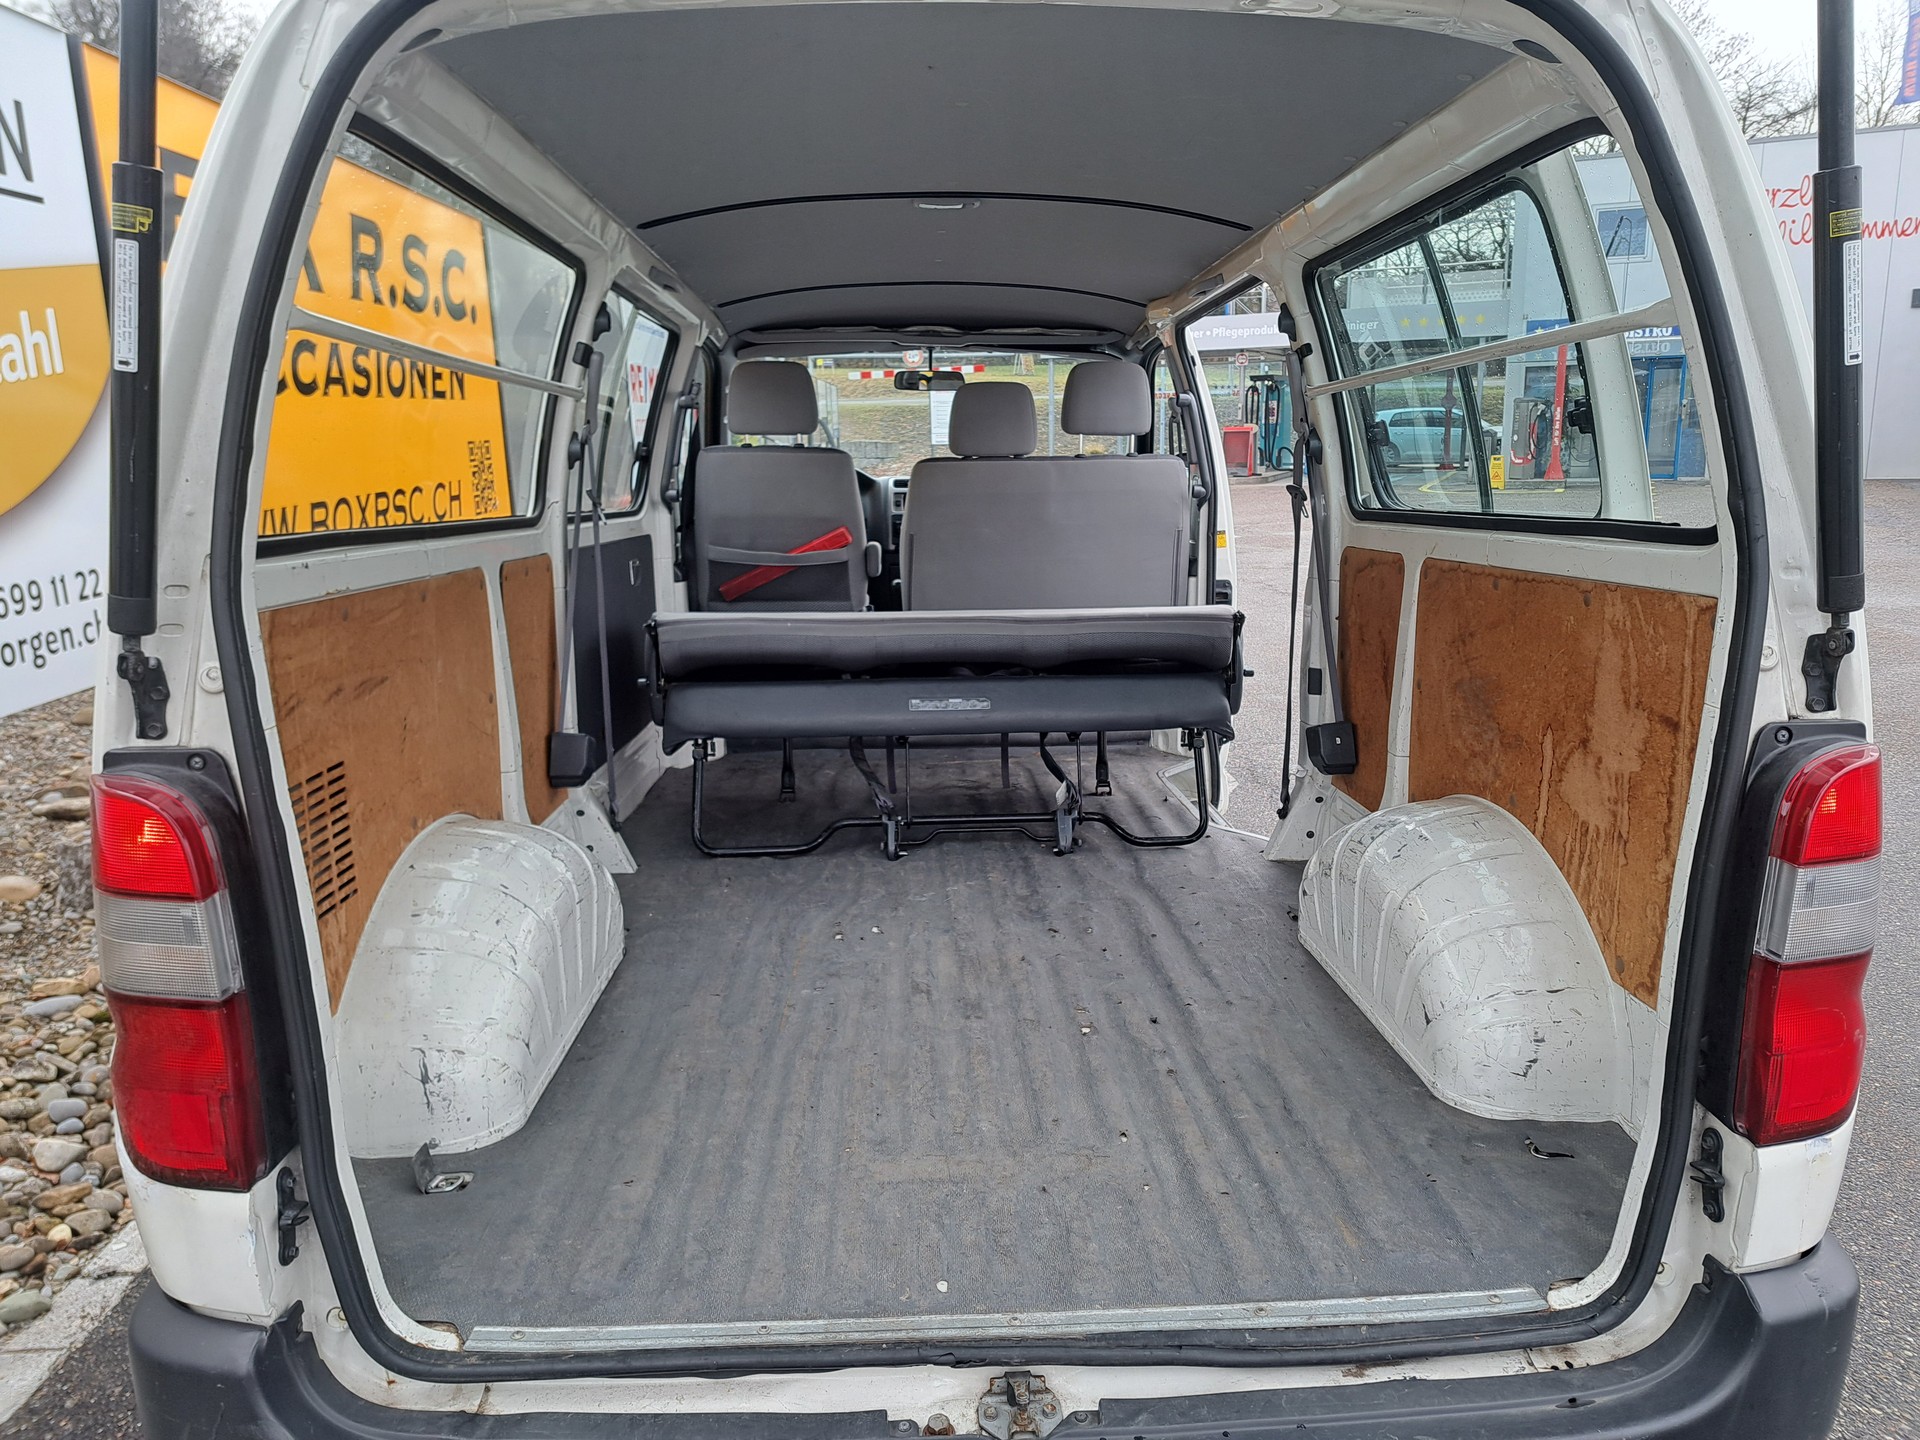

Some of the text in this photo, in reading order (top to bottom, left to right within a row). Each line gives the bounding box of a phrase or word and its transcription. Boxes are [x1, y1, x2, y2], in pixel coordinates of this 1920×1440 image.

[1765, 174, 1813, 209] rzl
[349, 213, 478, 325] R.S.C.
[0, 307, 65, 384] ahl
[1624, 326, 1673, 338] ISTRO
[276, 339, 466, 400] CASIONEN
[50, 577, 69, 607] 11
[75, 568, 103, 601] 22
